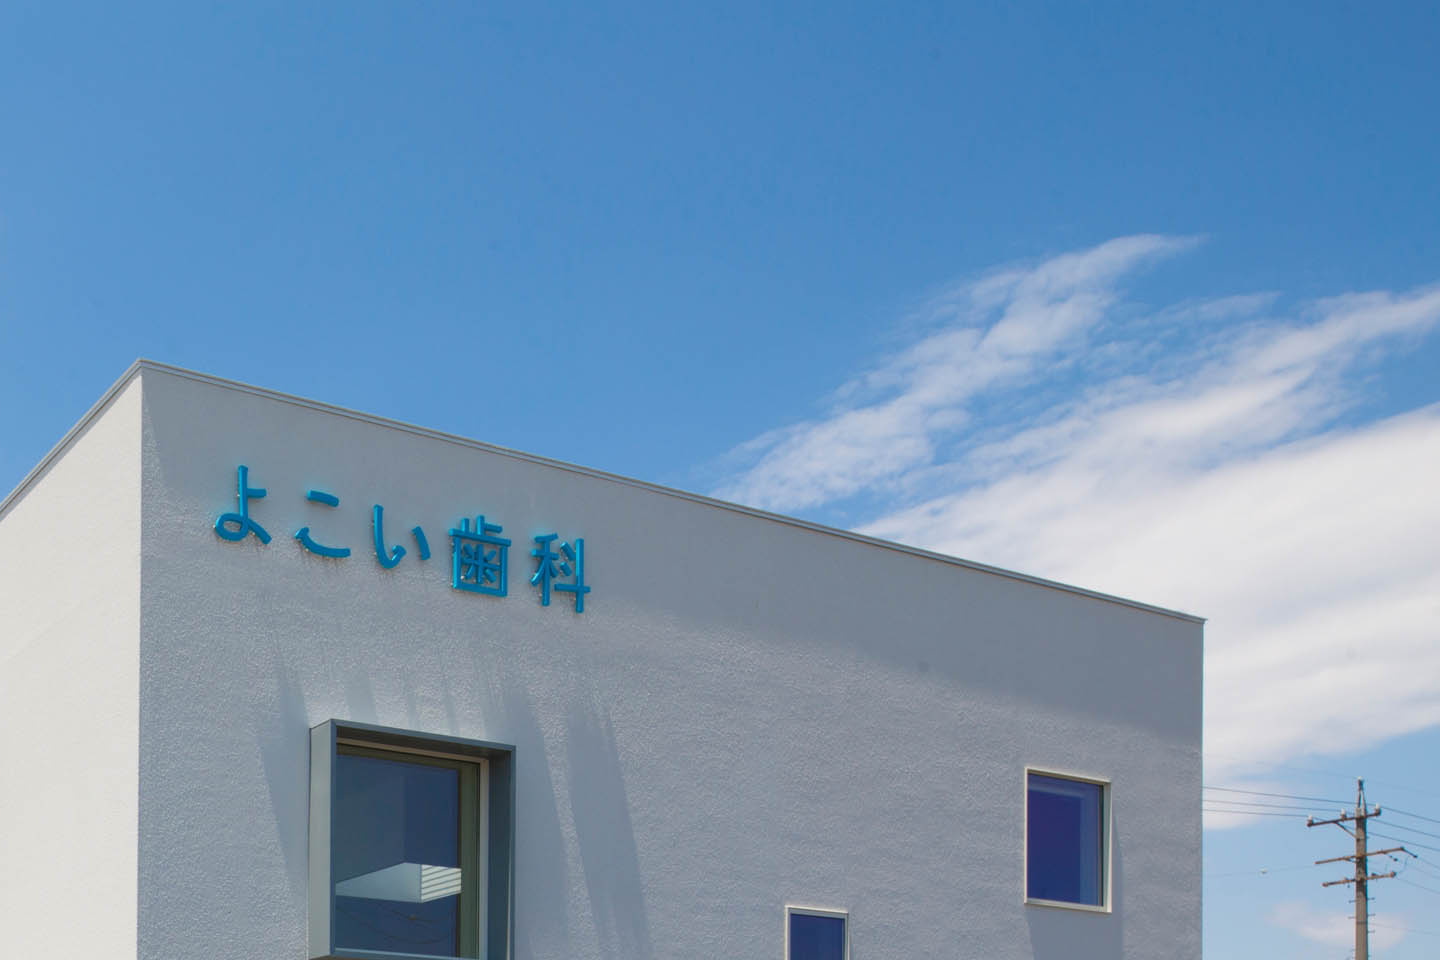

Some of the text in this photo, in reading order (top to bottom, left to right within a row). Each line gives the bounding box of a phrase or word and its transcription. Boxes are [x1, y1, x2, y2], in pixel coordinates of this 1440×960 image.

[213, 464, 591, 614] よこい歯科
